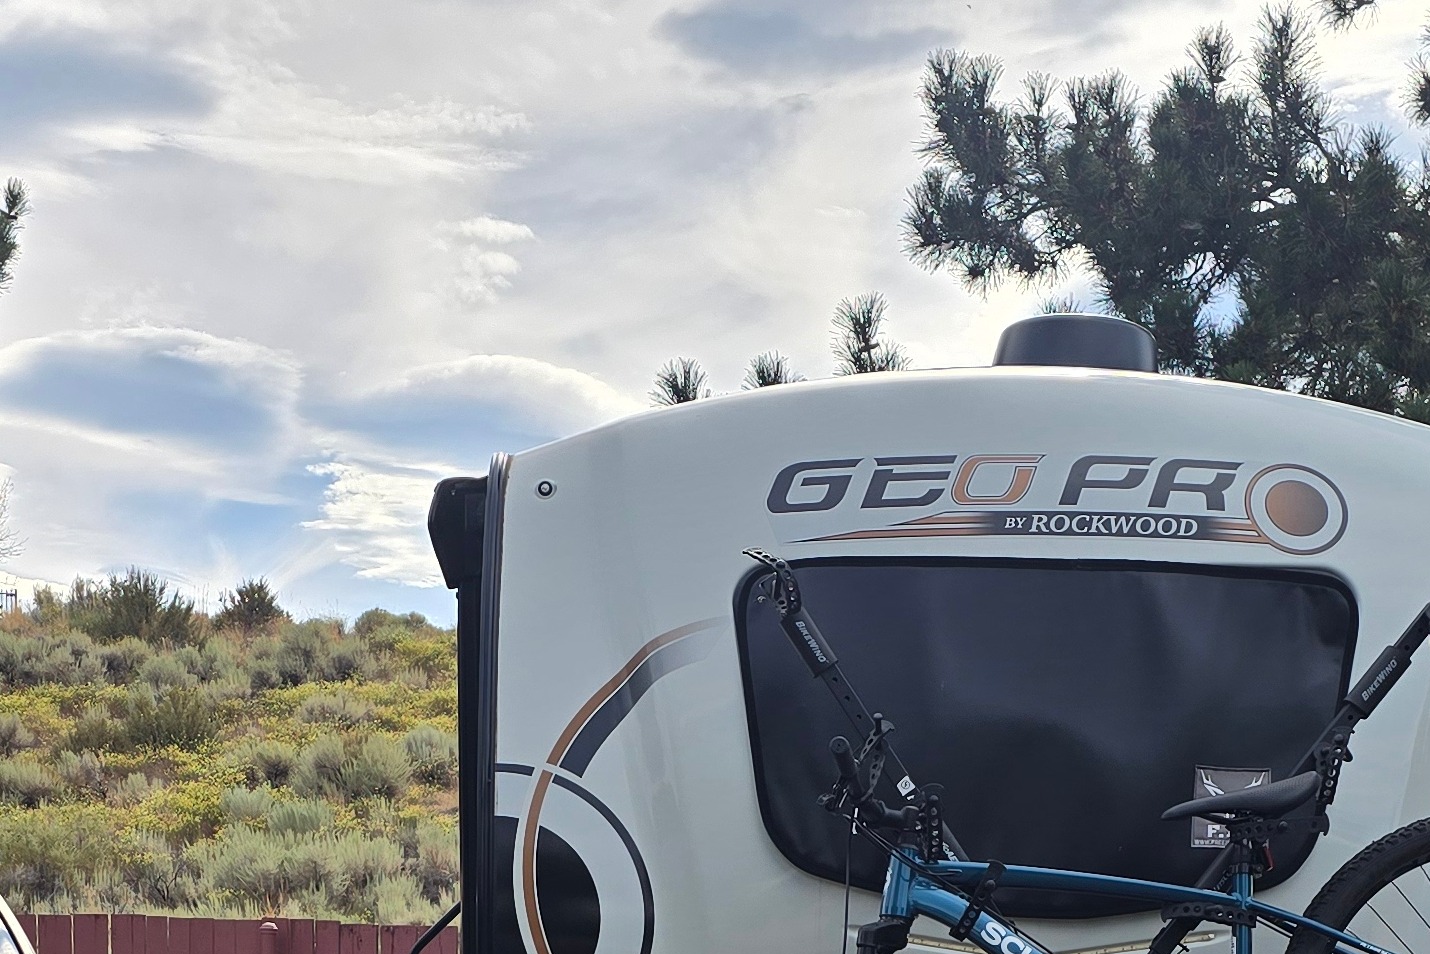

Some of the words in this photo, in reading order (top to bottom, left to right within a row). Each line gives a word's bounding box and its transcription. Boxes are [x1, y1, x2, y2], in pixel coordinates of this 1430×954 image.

[767, 454, 1046, 514] GEO
[1058, 455, 1348, 555] PRO
[1004, 517, 1027, 529] BY
[1029, 514, 1198, 537] ROCKWOOD
